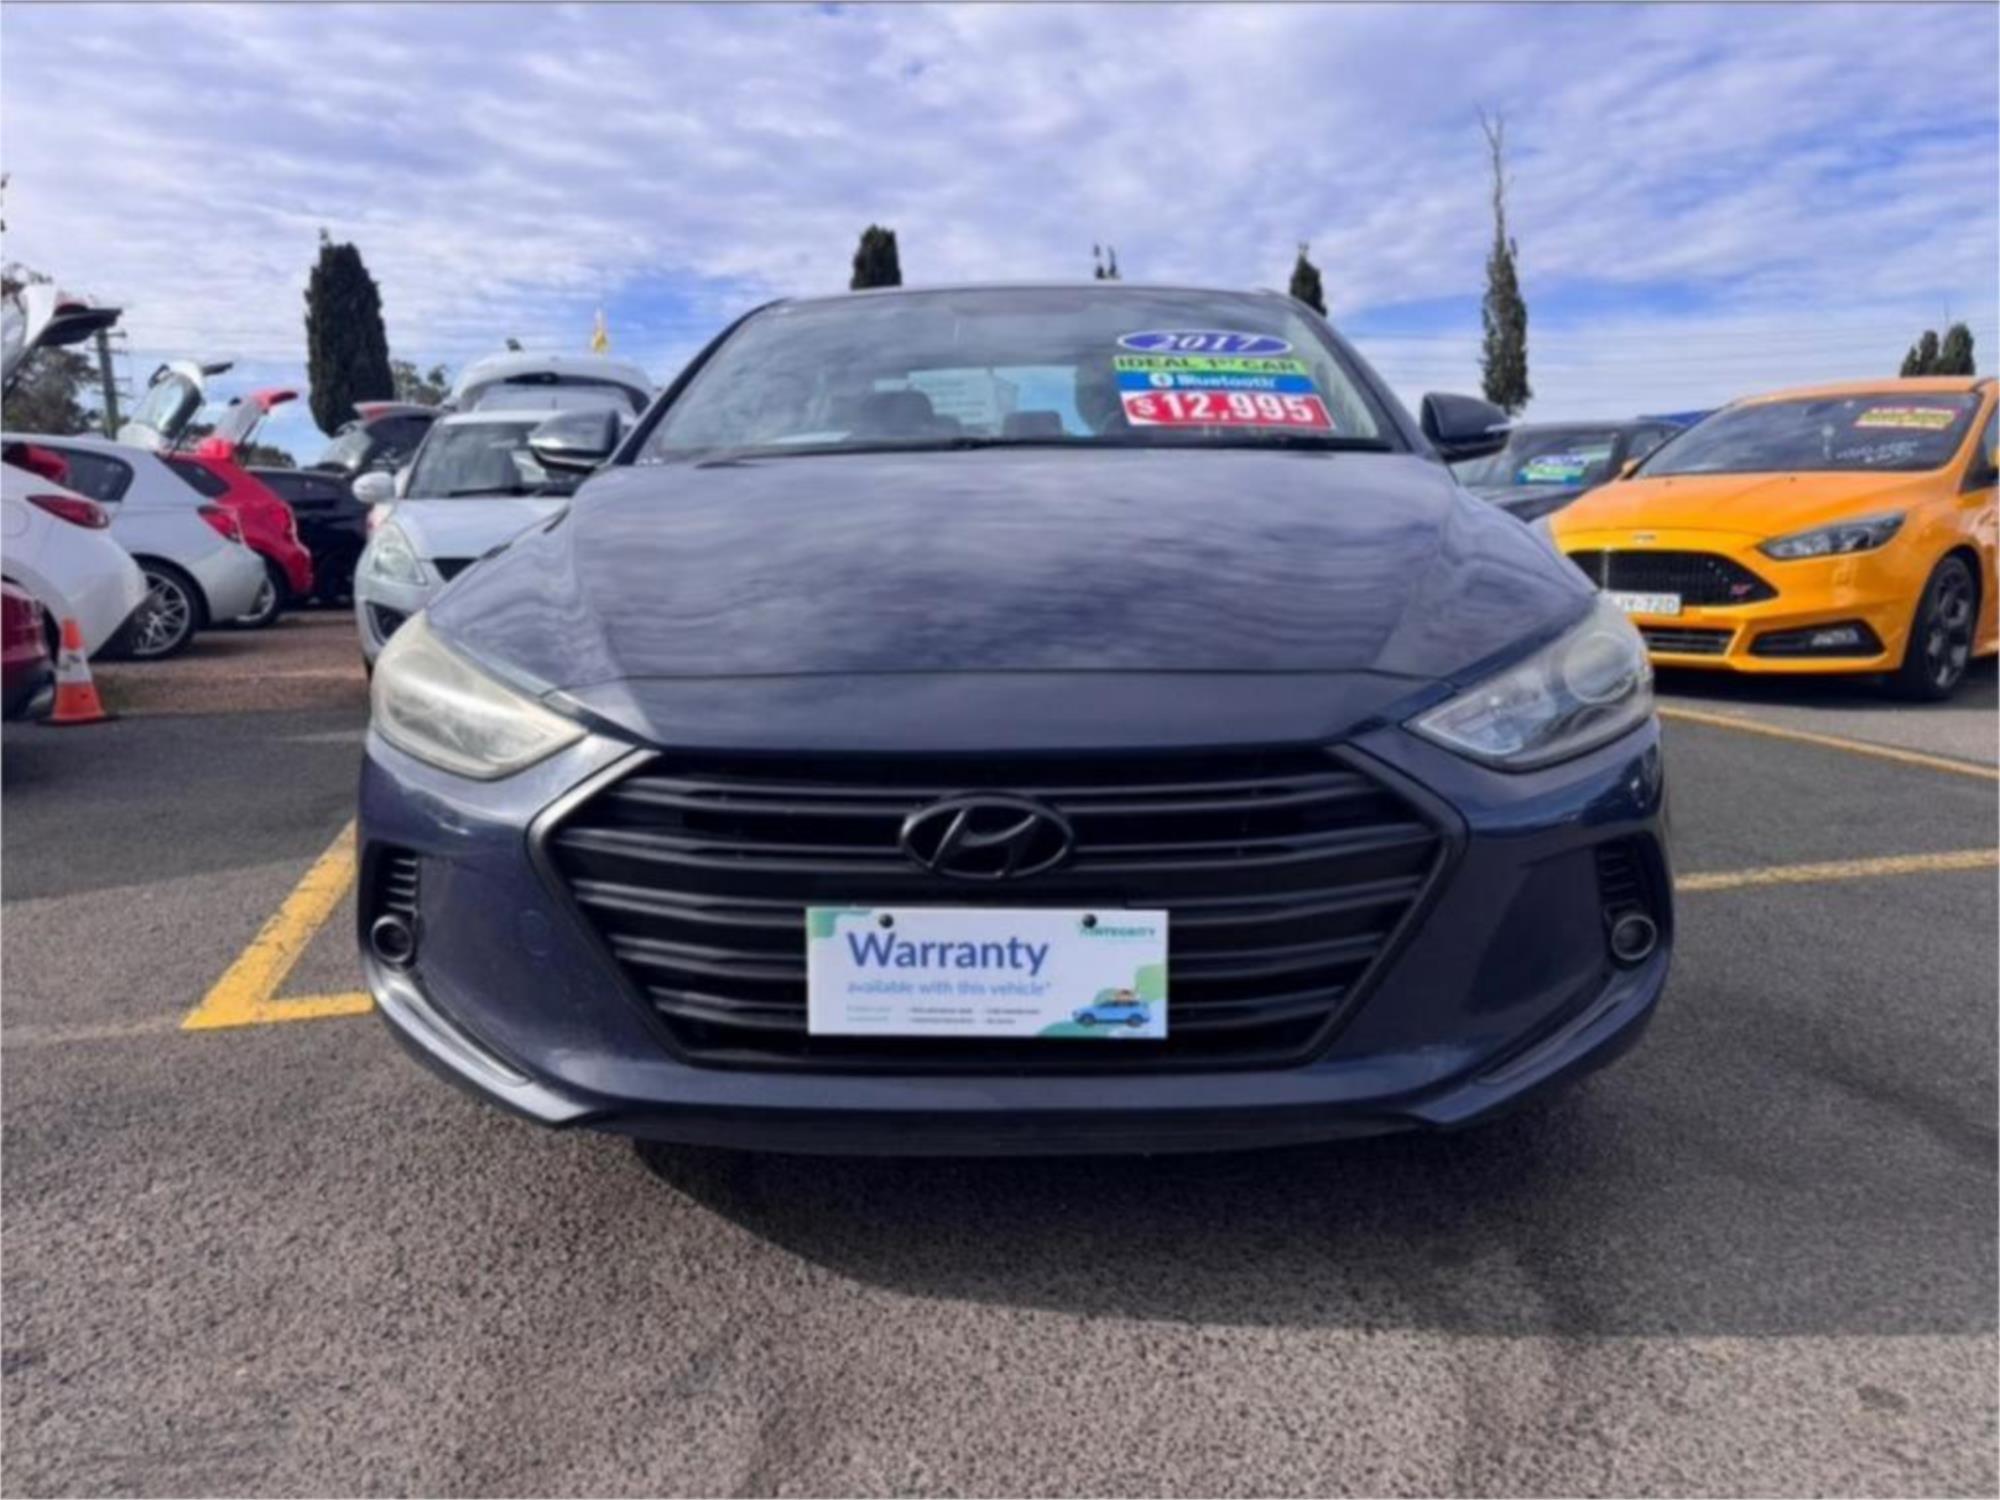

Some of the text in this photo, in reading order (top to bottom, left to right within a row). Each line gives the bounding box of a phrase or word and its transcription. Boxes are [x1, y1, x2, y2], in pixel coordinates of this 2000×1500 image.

[1150, 333, 1261, 351] 2017
[1118, 357, 1191, 369] IDEAL
[1241, 361, 1297, 372] CAR
[848, 931, 1048, 976] Warranty
[848, 980, 913, 995] available
[918, 980, 952, 995] with
[957, 981, 986, 996] this
